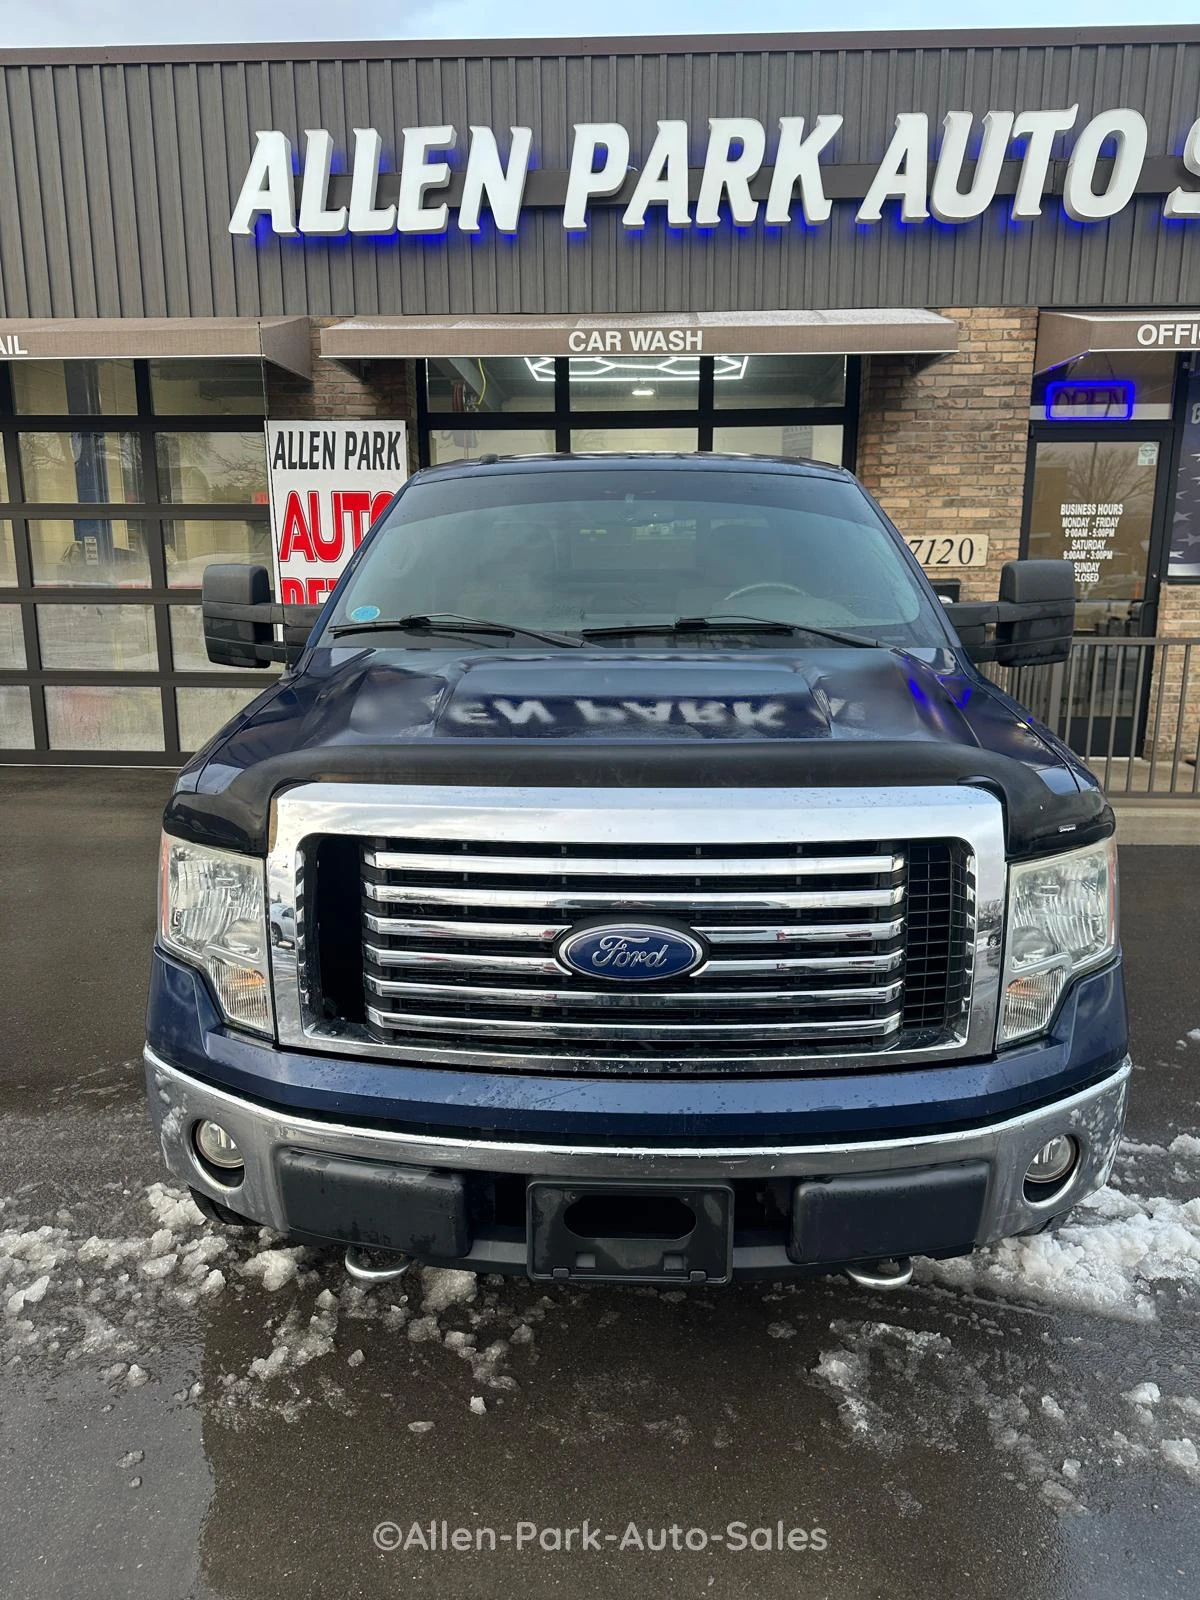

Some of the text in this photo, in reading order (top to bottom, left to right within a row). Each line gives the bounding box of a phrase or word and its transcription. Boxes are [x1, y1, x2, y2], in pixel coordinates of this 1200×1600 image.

[228, 123, 533, 237] ALLEN
[562, 114, 844, 231] PARK
[855, 103, 1148, 224] AUTO
[568, 330, 703, 351] CAR WASH
[1137, 323, 1200, 345] OFFI
[272, 431, 401, 470] ALLEN PARK
[1060, 503, 1124, 516] BUSINESS HOURS
[1061, 516, 1090, 528] MONDAY
[1095, 516, 1120, 528] FRIDAY
[908, 537, 974, 565] 7120
[1071, 539, 1107, 550] SATURDAY
[1073, 562, 1101, 573] SUNDAY
[591, 935, 669, 968] Ford
